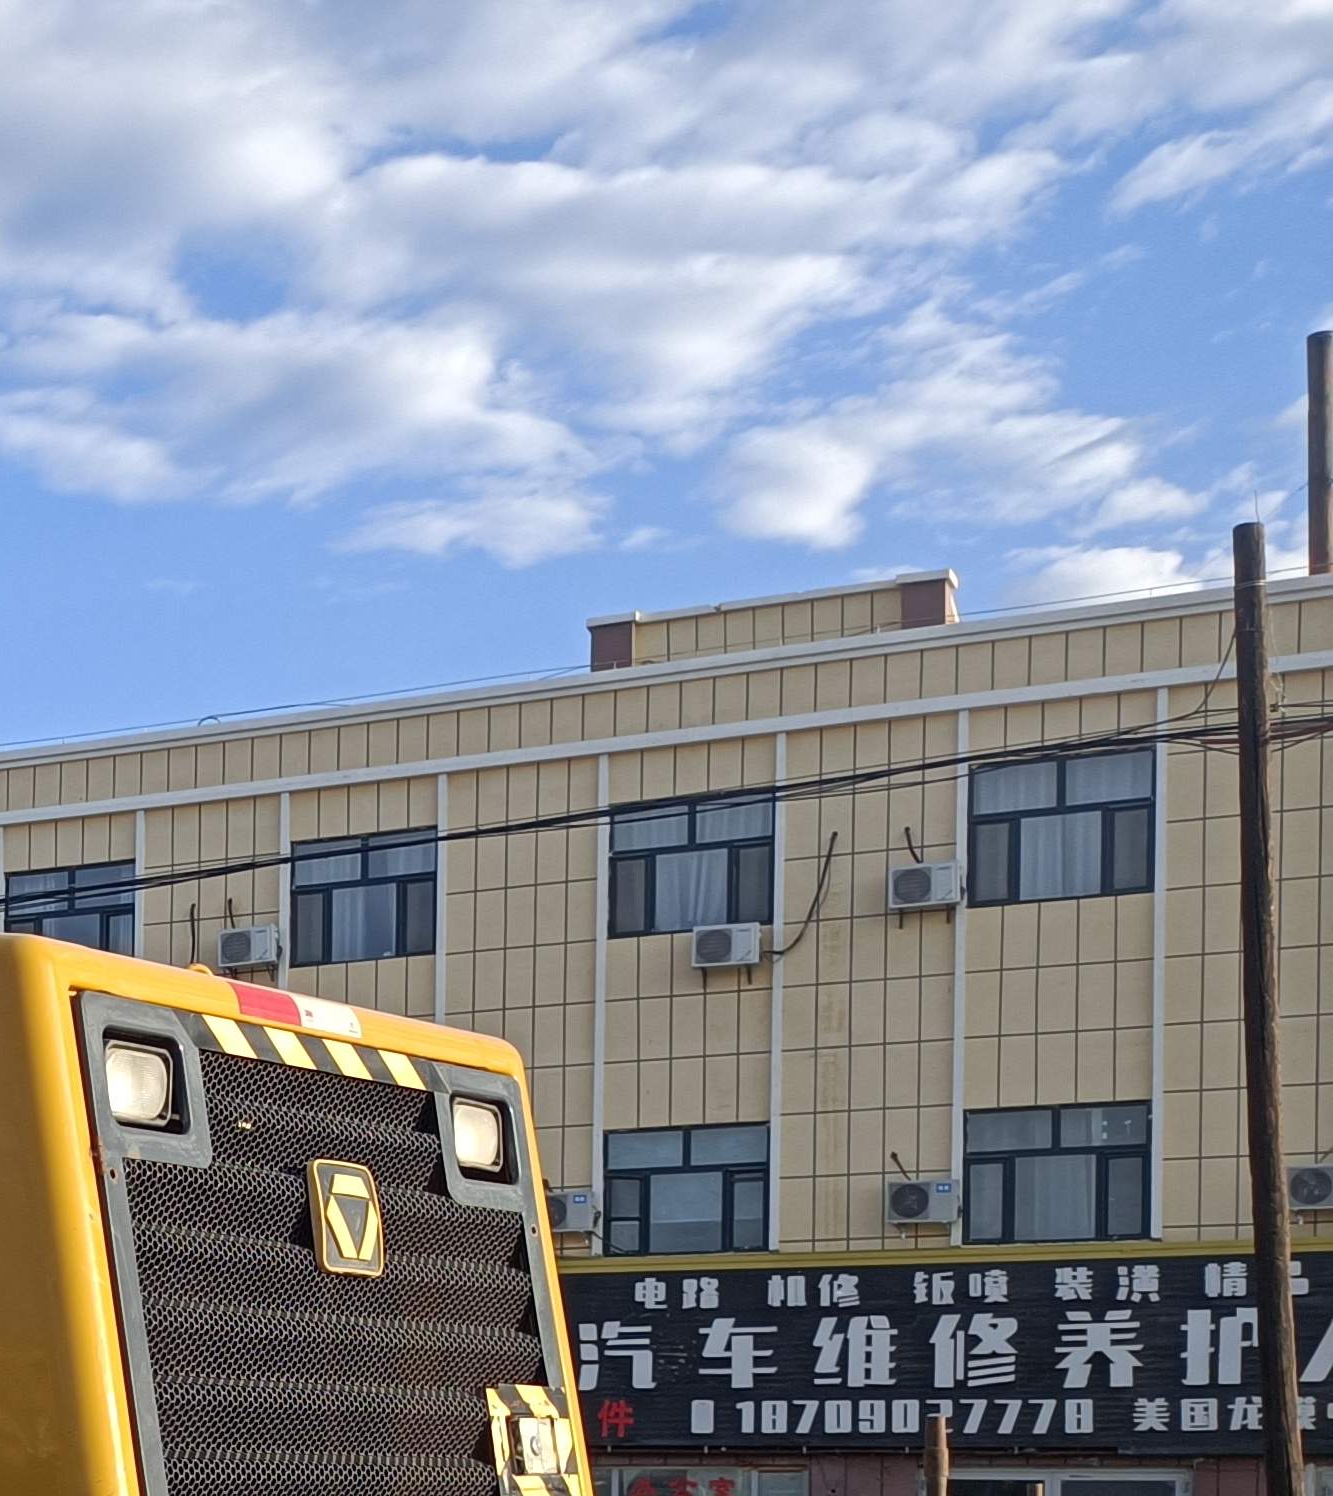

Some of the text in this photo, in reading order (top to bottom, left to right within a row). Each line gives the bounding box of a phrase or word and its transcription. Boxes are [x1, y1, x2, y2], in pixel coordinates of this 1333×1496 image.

[634, 1276, 720, 1310] 电路
[767, 1273, 860, 1308] 机修
[913, 1269, 1009, 1306] 钣喷
[1054, 1264, 1161, 1304] 装潢
[578, 1307, 1333, 1391] 汽车维修养护
[597, 1399, 634, 1438] 件
[736, 1399, 1094, 1435] 18709027778
[1133, 1395, 1333, 1432] 美国龙
